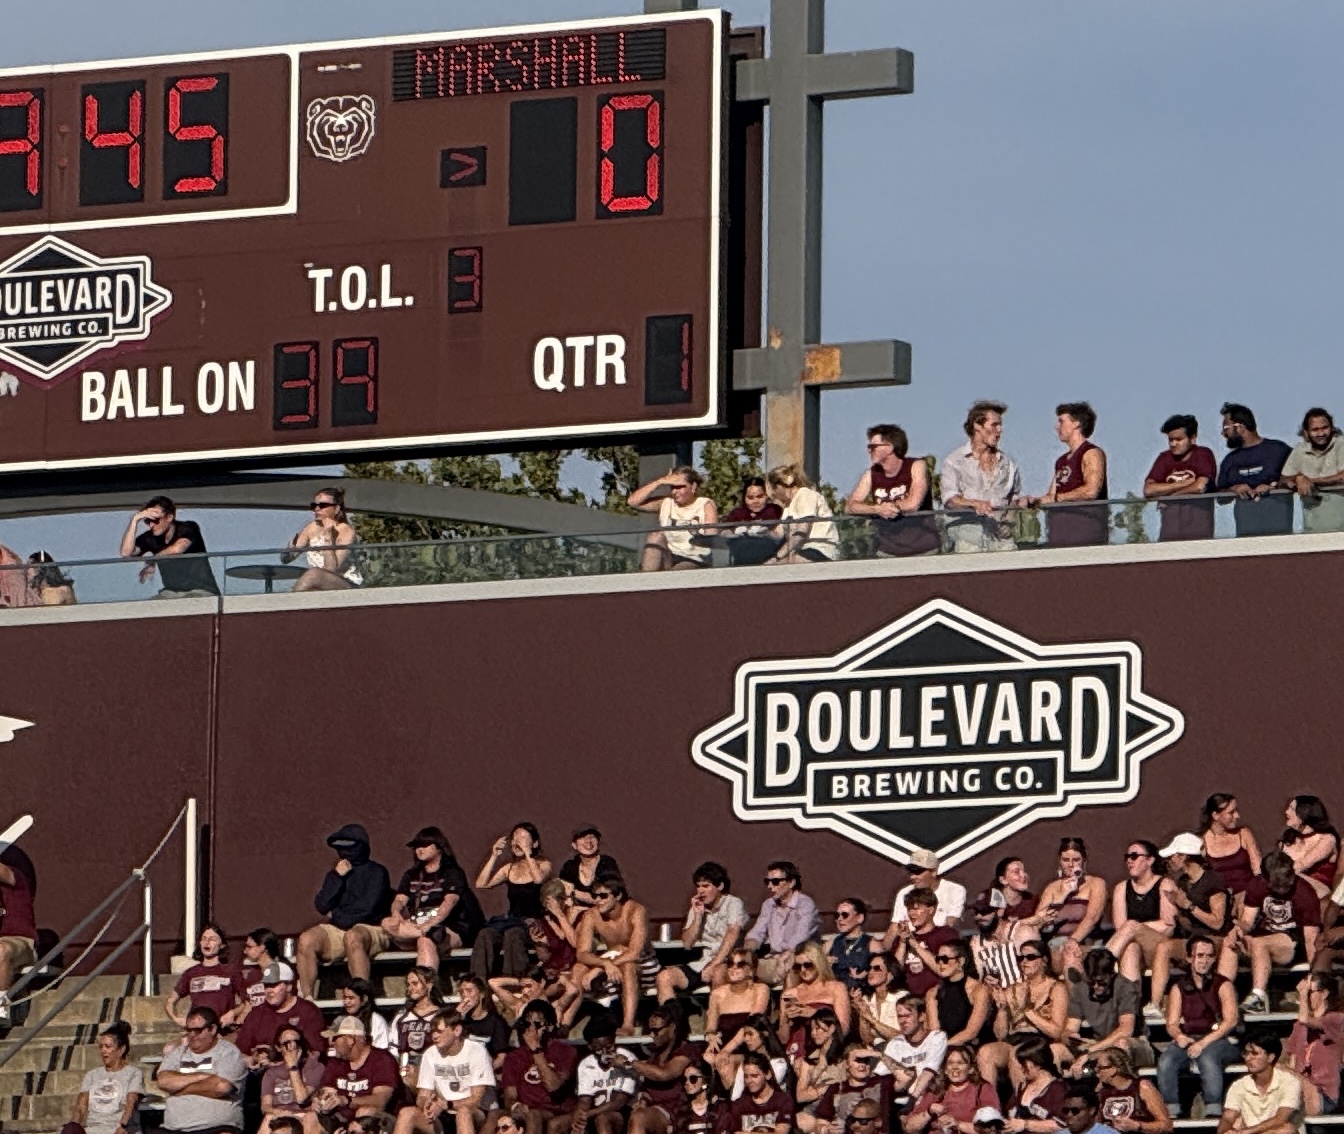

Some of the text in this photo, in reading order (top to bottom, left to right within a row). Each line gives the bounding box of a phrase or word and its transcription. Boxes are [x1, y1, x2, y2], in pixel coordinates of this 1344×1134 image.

[415, 32, 642, 98] MARSHALL
[601, 94, 660, 212] 0
[308, 264, 414, 312] T.O.L.
[452, 248, 480, 308] 3
[77, 321, 103, 335] CO.
[81, 361, 256, 421] BALL ON
[534, 334, 627, 392] QTR
[765, 676, 1110, 787] BOULEVARD
[832, 765, 1043, 799] BREWING CO.
